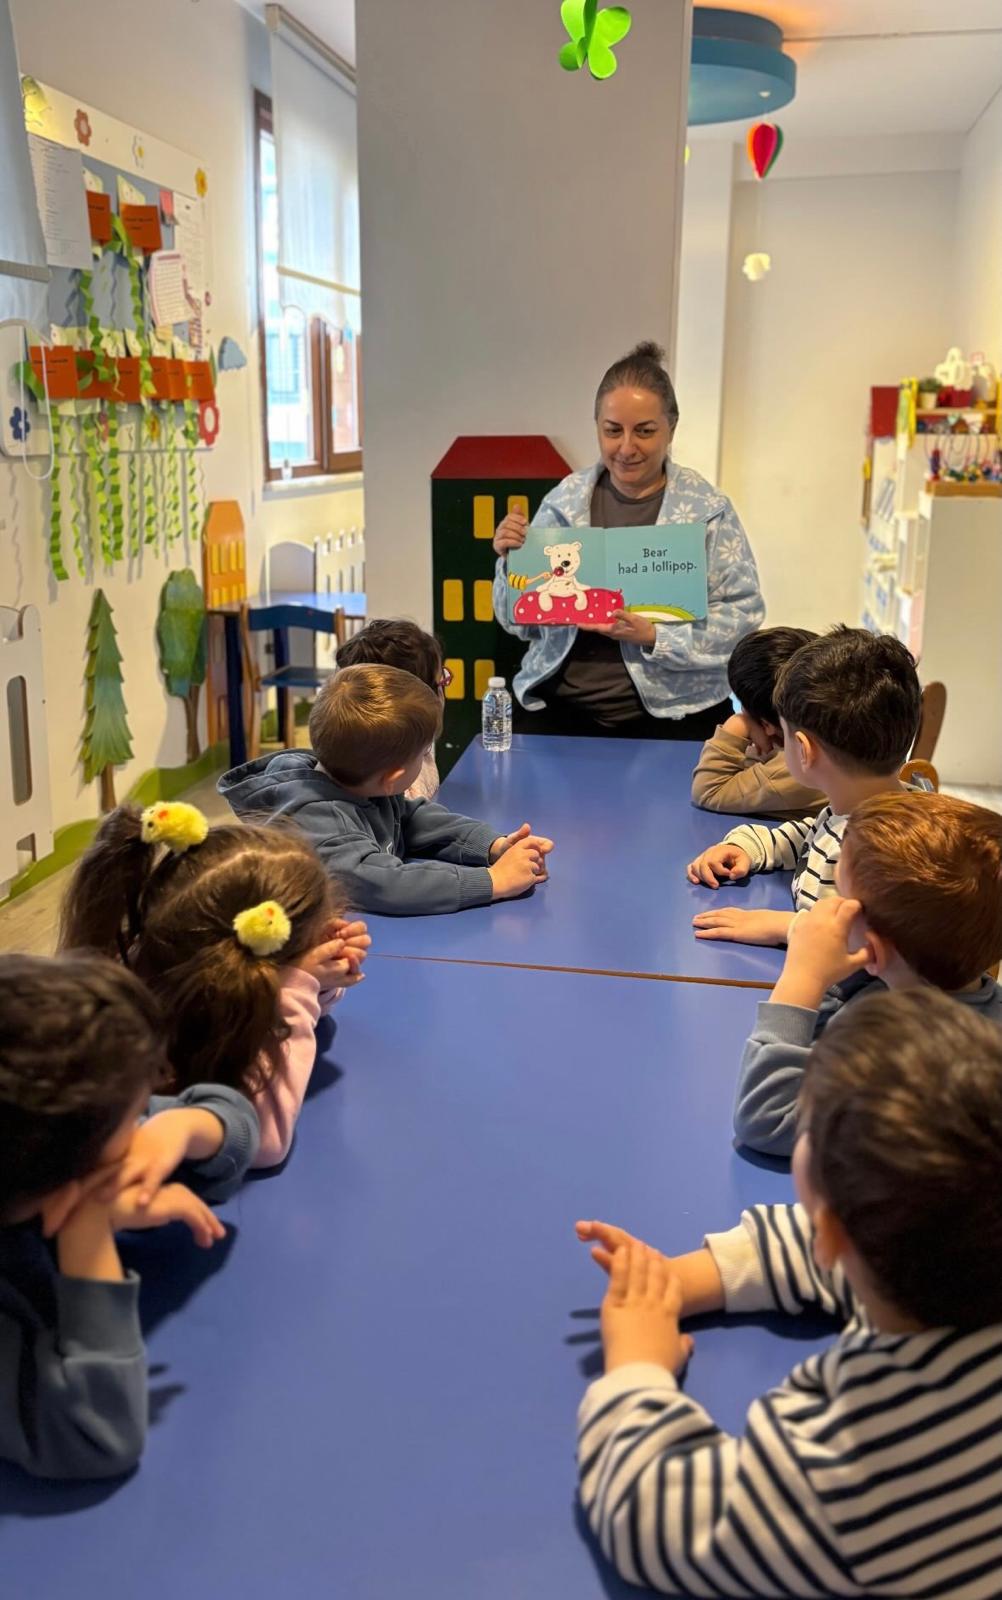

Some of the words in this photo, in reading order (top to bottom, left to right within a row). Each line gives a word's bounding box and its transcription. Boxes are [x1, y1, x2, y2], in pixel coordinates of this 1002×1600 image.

[643, 548, 668, 558] Bear
[618, 562, 638, 574] had
[642, 565, 648, 573] a
[652, 561, 697, 574] lollipop.
